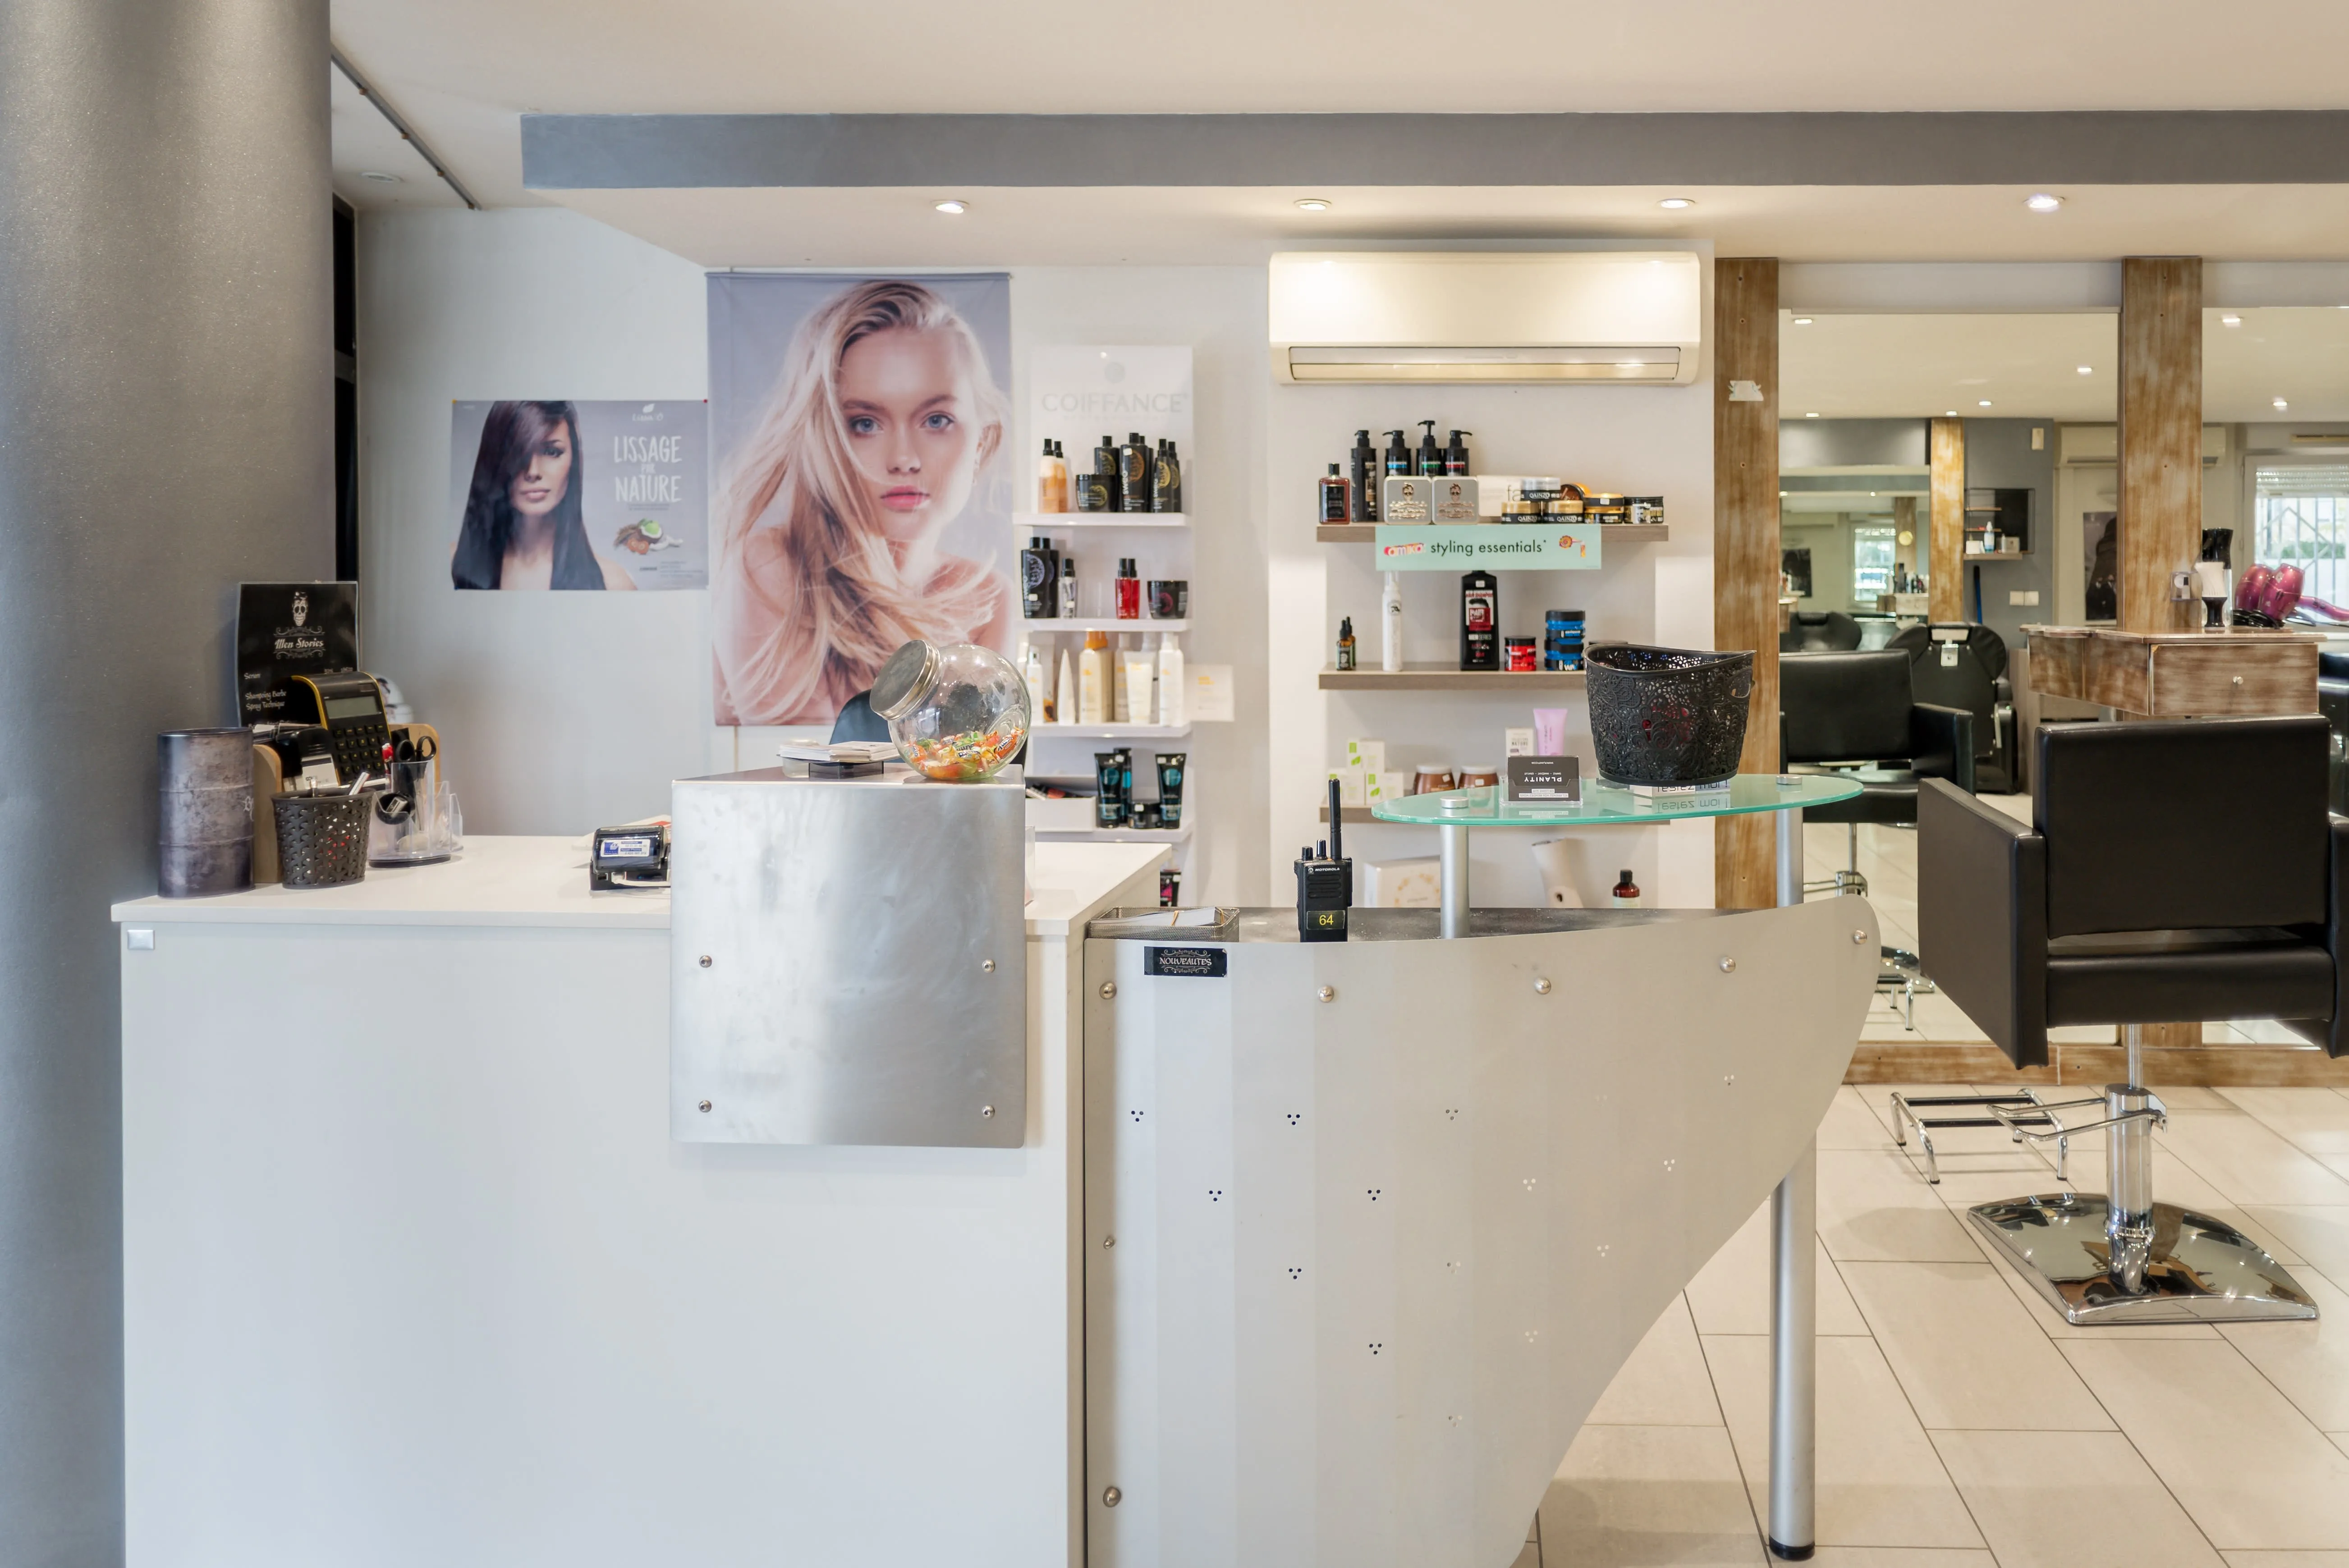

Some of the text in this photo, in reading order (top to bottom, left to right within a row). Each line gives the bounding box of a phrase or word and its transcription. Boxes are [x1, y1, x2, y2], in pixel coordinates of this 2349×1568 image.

[1041, 392, 1182, 413] COIFFANCE
[614, 435, 682, 463] LISSAGE
[615, 474, 682, 503] NATURE
[1431, 541, 1473, 556] styling
[274, 637, 325, 649] Men Stories
[1319, 914, 1334, 925] 64
[1159, 957, 1212, 966] NOUVEAUTES
